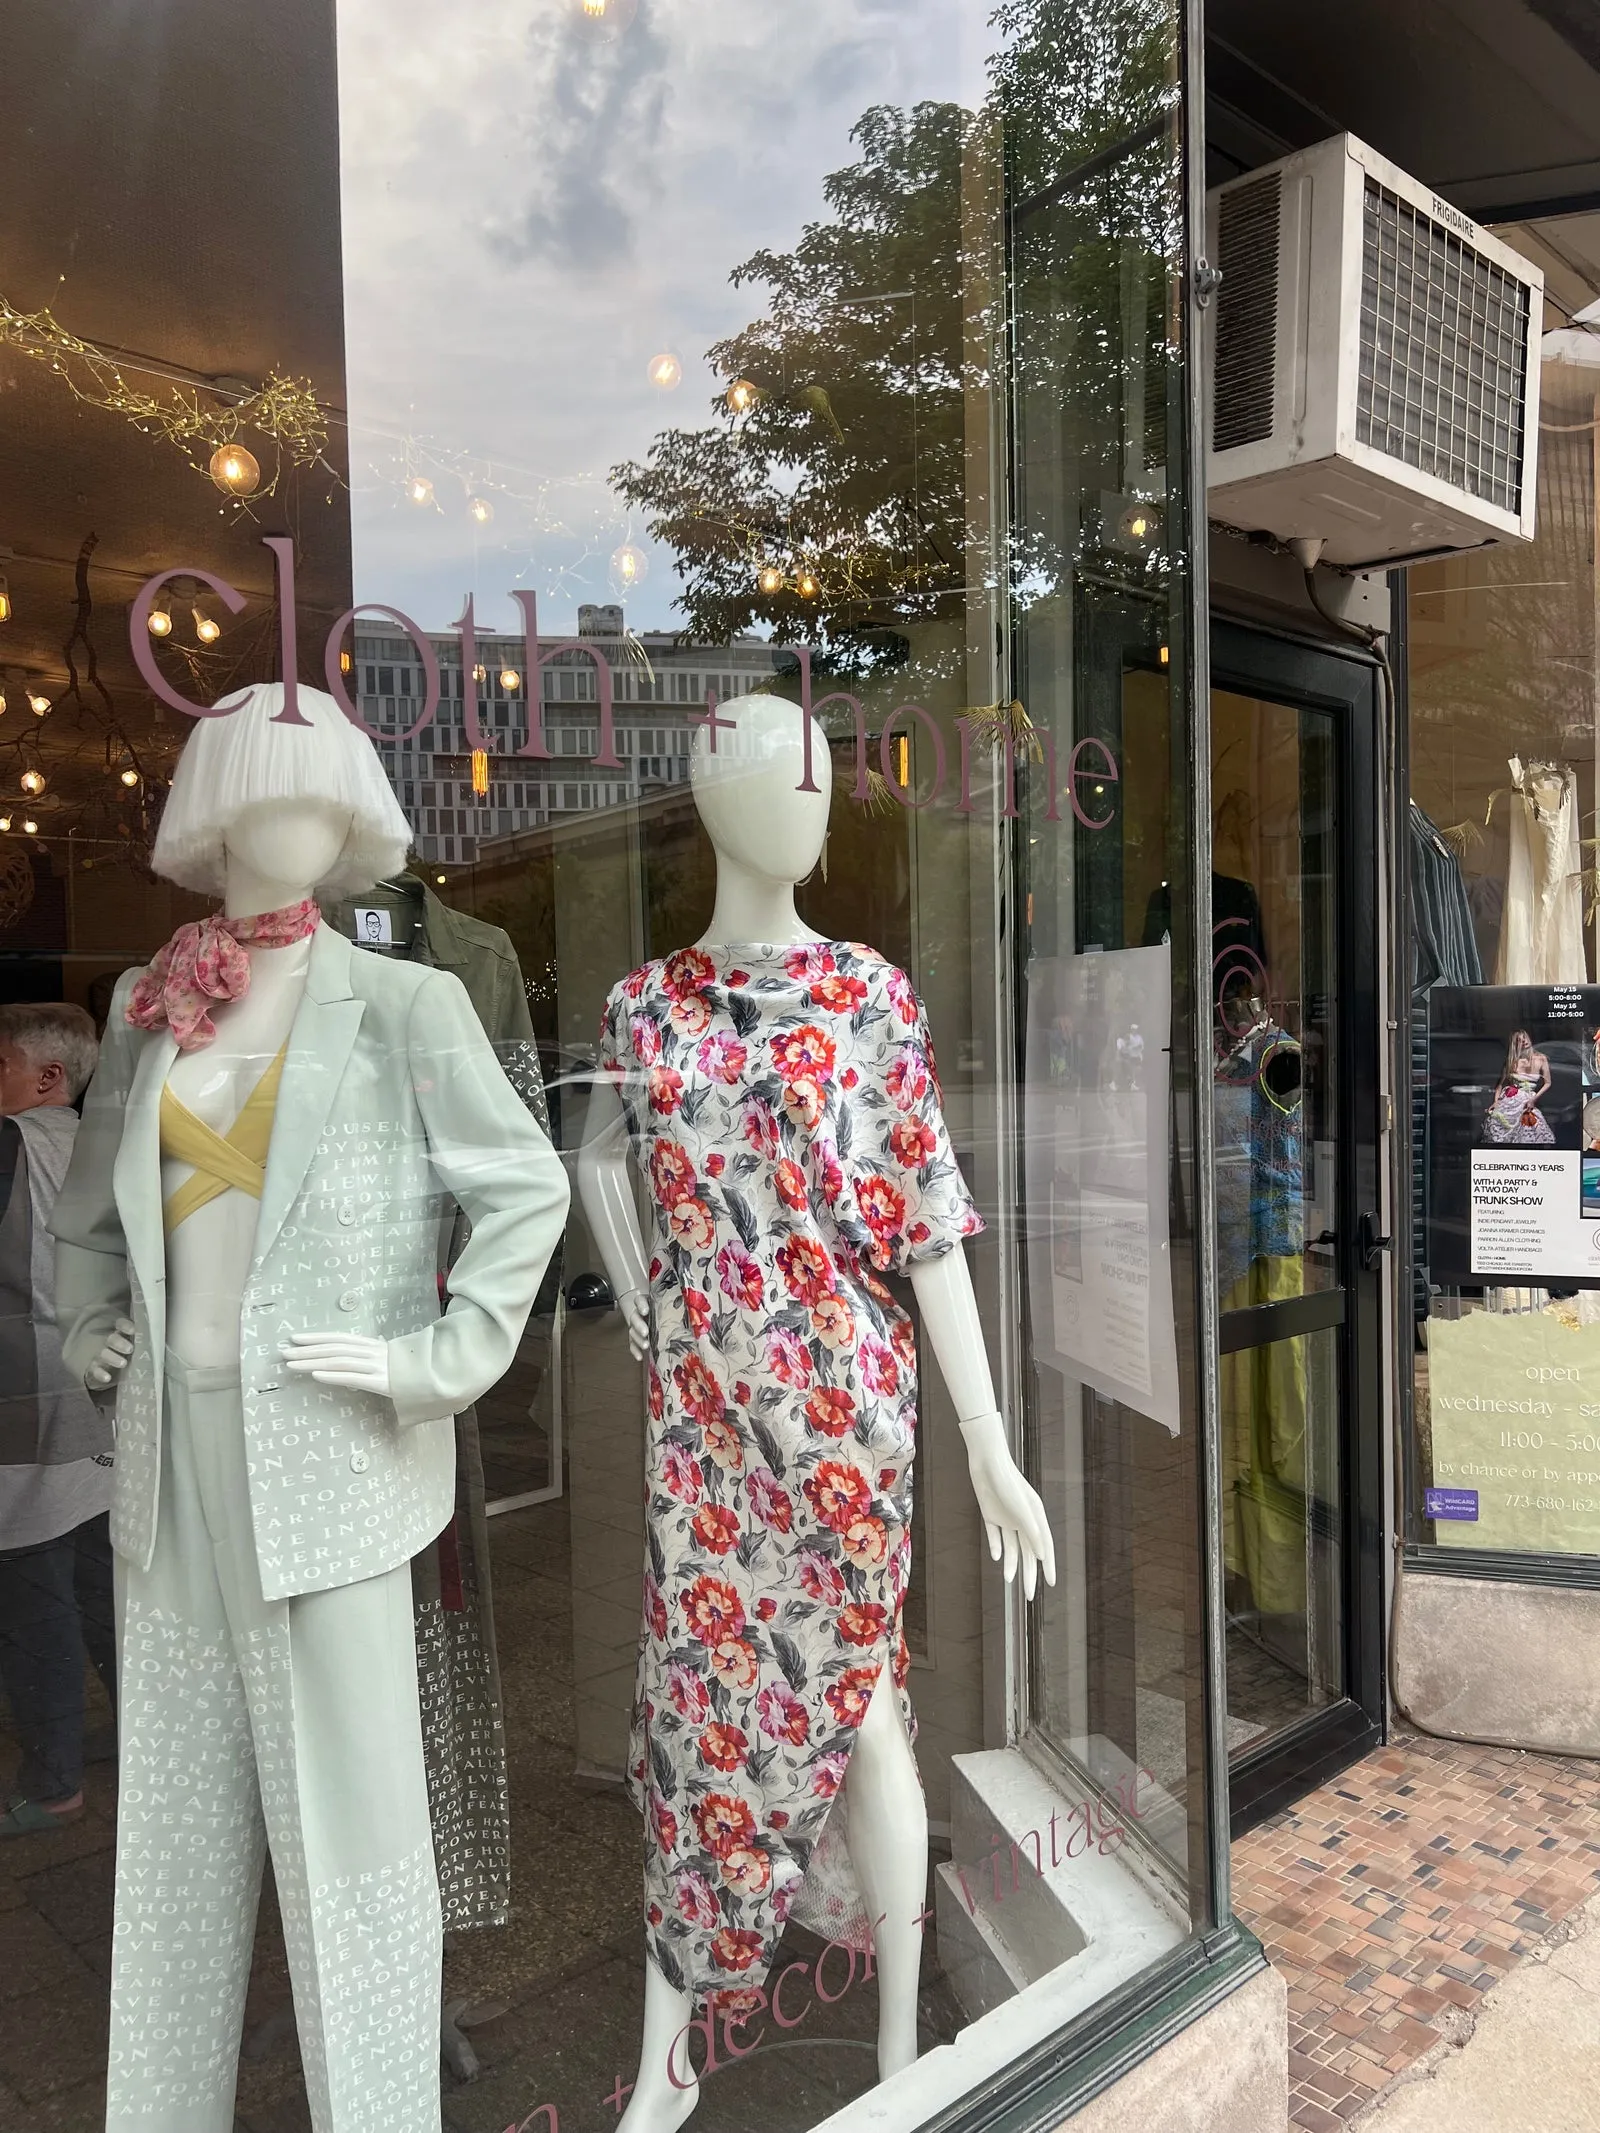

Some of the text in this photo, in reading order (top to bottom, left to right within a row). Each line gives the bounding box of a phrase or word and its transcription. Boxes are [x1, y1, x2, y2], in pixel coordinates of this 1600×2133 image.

[1432, 196, 1474, 239] FRIGIDAIRE
[130, 537, 624, 768] cloth
[792, 644, 1119, 829] home
[1472, 1163, 1529, 1171] CELEBRATING
[1472, 1195, 1543, 1206] TRUNK SHOW
[1526, 1367, 1580, 1383] open
[1438, 1395, 1556, 1418] wednesday
[256, 1425, 344, 1453] HOPE
[1501, 1432, 1543, 1449] 11:00
[1438, 1461, 1456, 1476] by
[1461, 1462, 1518, 1478] chance
[1521, 1468, 1538, 1479] or
[1544, 1467, 1561, 1483] by
[295, 1488, 336, 1507] TO
[324, 1521, 356, 1540] IN
[358, 1527, 391, 1550] BY
[277, 1554, 363, 1588] HOPE
[149, 1772, 231, 1795] HOPE
[170, 1833, 207, 1846] TO
[187, 1868, 219, 1881] IN
[136, 1902, 220, 1915] HOPE
[326, 1892, 406, 1930] FROM
[666, 1912, 887, 2090] decor
[957, 1767, 1155, 1917] vintage
[161, 1958, 198, 1973] TO
[128, 2023, 209, 2043] HOPE
[341, 2011, 417, 2056] FROM
[152, 2082, 188, 2098] TO
